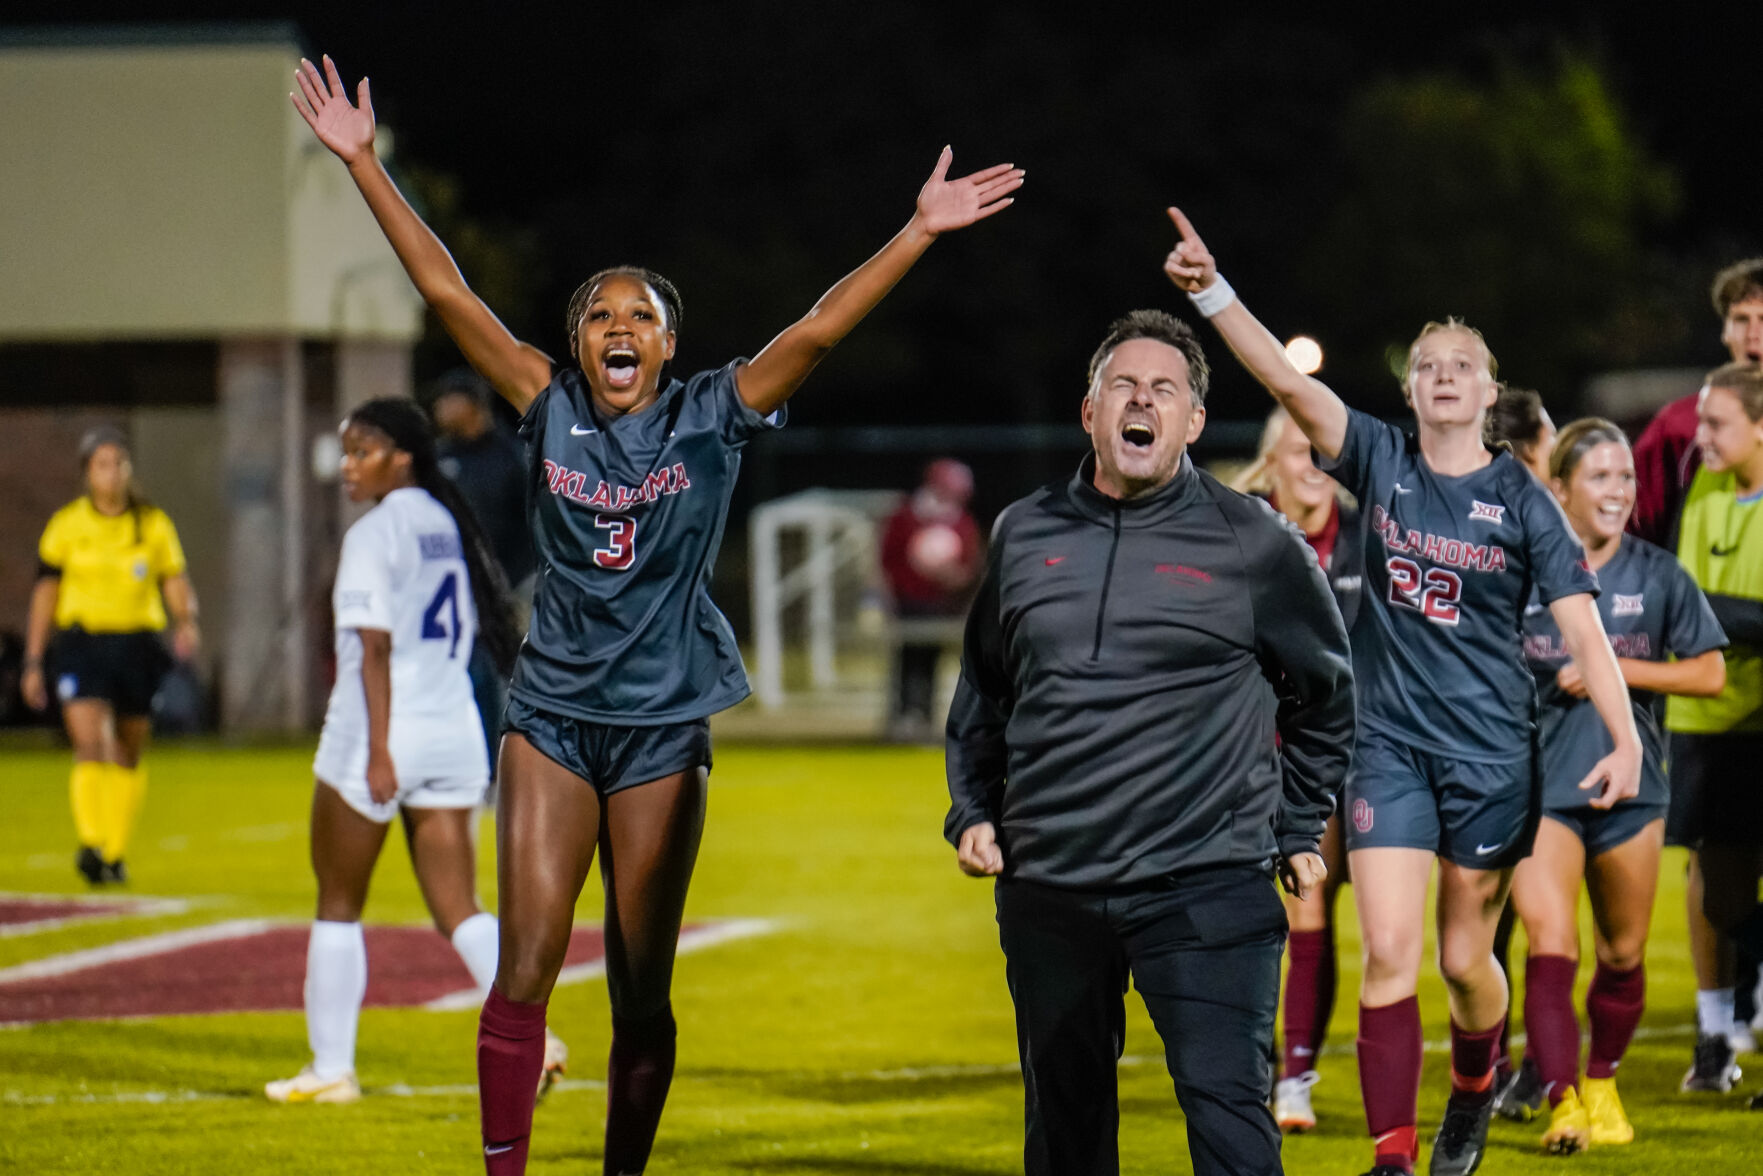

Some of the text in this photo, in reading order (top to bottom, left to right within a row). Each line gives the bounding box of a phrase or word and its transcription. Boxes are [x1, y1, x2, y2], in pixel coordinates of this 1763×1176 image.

[593, 513, 637, 570] 3
[420, 571, 462, 659] 4
[1386, 556, 1463, 627] 22
[1352, 798, 1374, 833] OU
